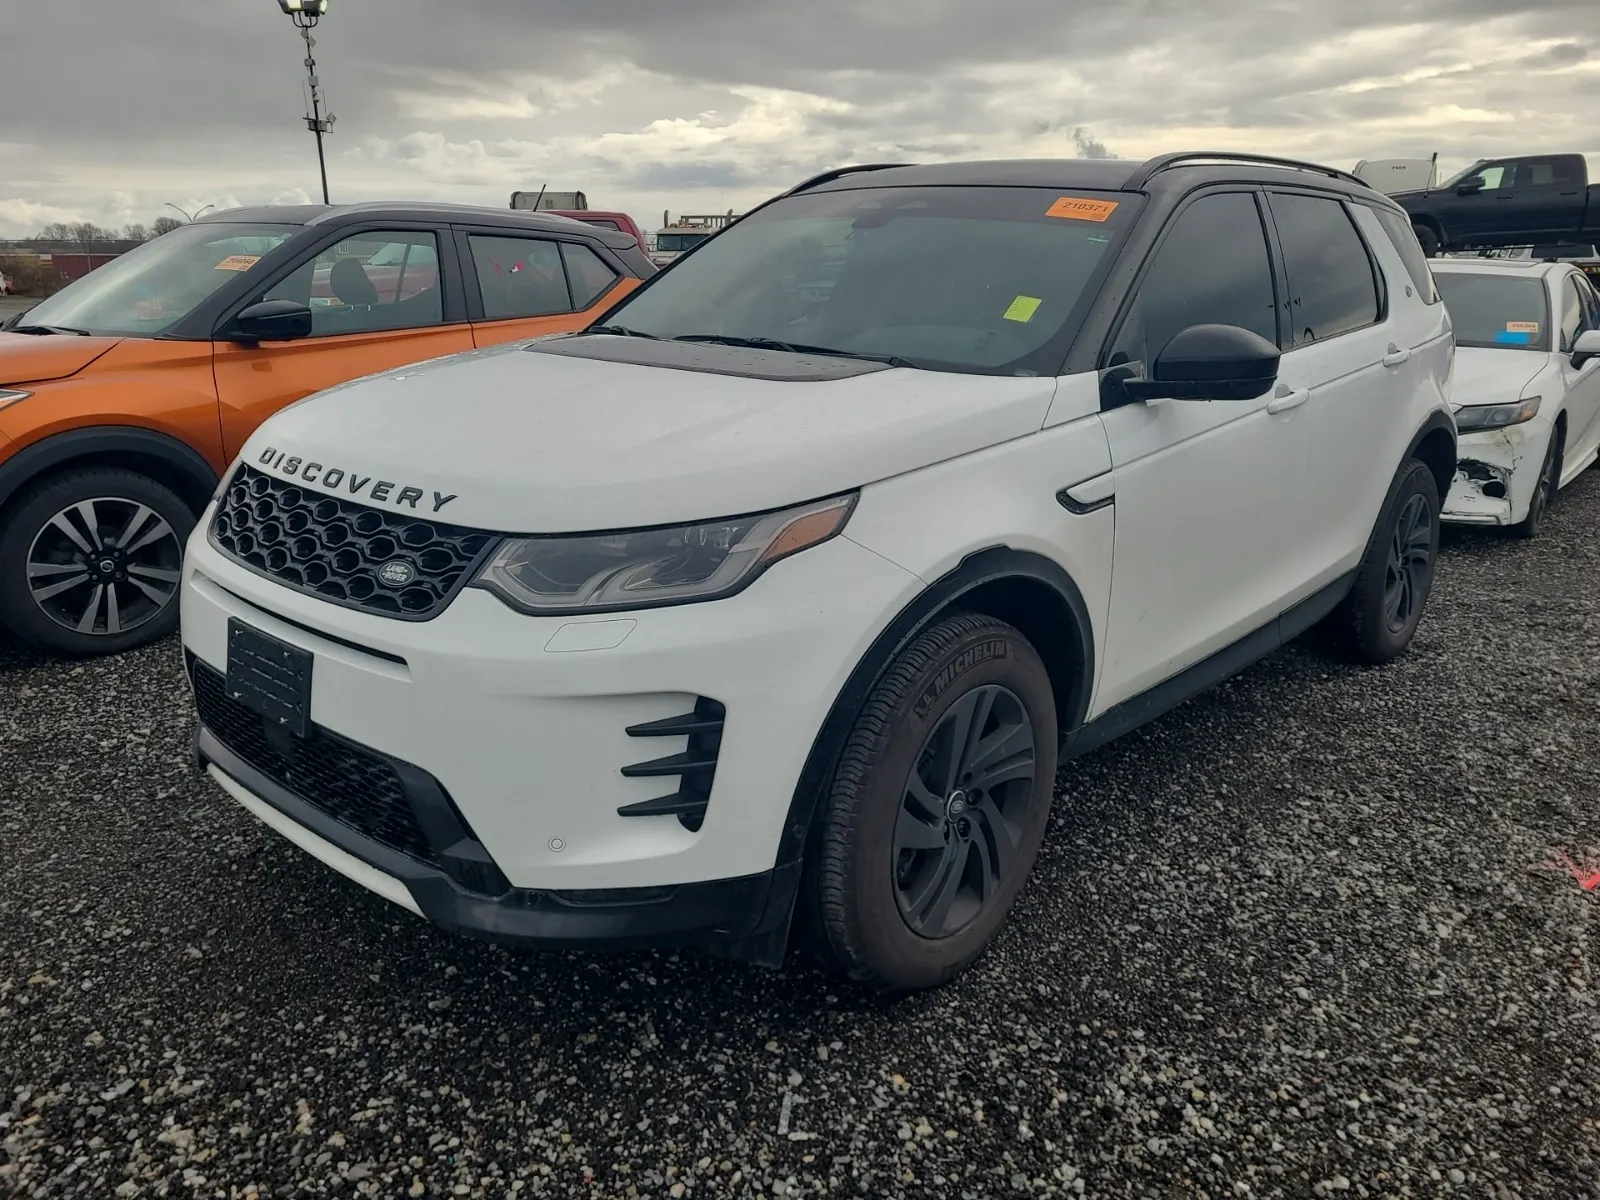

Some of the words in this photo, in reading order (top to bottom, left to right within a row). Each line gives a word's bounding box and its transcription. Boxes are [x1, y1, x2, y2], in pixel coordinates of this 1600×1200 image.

[1062, 201, 1110, 213] 210371
[258, 446, 458, 512] DISCOVERY
[933, 640, 1007, 696] MICHELIN
